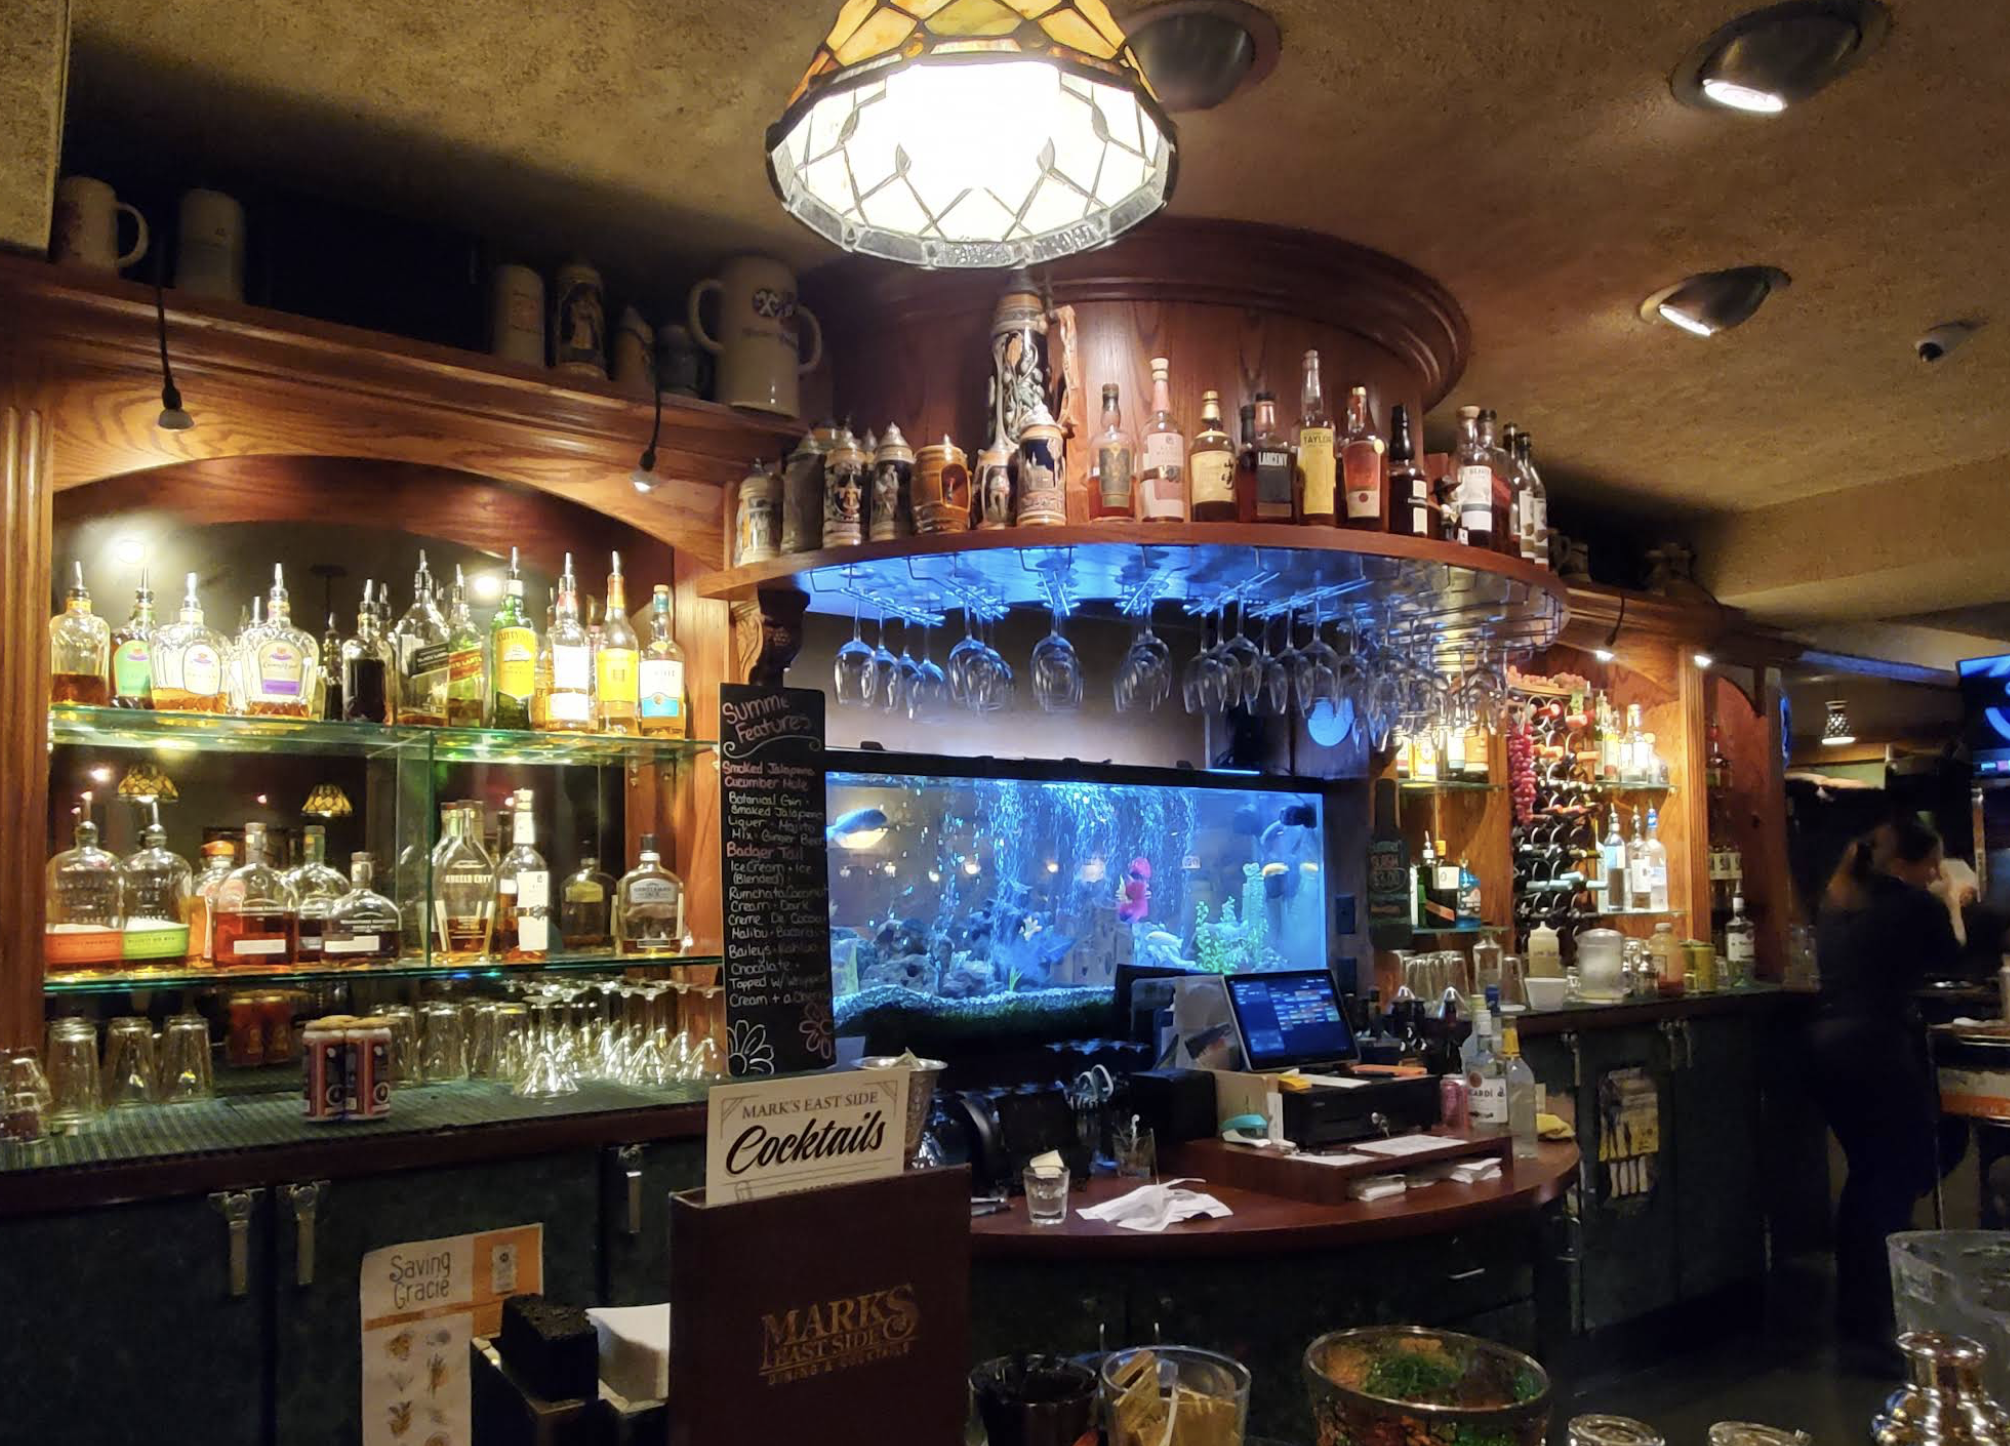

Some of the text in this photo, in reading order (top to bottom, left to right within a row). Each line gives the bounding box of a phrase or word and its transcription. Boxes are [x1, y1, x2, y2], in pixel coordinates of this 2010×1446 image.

[735, 714, 811, 743] Features
[724, 776, 779, 789] Cucumber
[726, 841, 774, 861] Badger
[731, 900, 809, 912] Cream Dark
[732, 927, 768, 940] Malibu
[731, 960, 791, 976] Chocolate
[728, 975, 767, 992] Topped
[729, 993, 768, 1008] Cream
[742, 1091, 879, 1120] MARK'S EAST SIDE
[726, 1110, 886, 1175] Cocktails
[389, 1251, 450, 1283] Saving
[394, 1280, 449, 1310] Gracie
